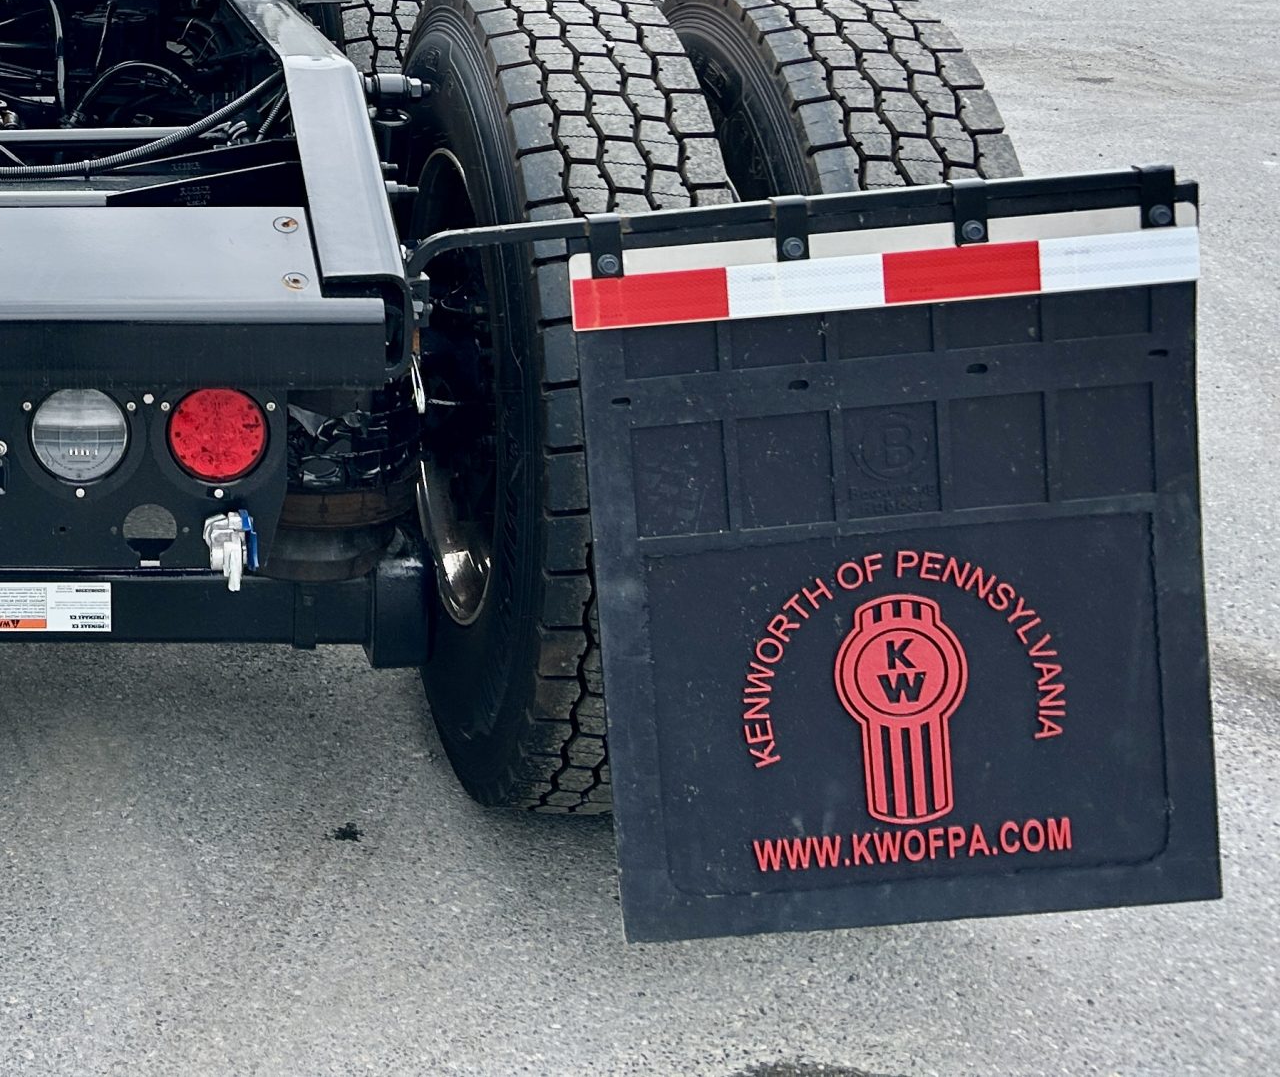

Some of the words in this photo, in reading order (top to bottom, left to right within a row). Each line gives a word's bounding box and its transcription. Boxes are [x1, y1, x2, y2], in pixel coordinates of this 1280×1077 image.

[743, 578, 833, 768] KENWORTH
[836, 553, 882, 590] OF
[896, 550, 1066, 739] PENNSYLVANIA
[885, 637, 917, 671] K
[876, 670, 927, 704] W
[753, 817, 1073, 872] WWW.KWOFPA.COM
